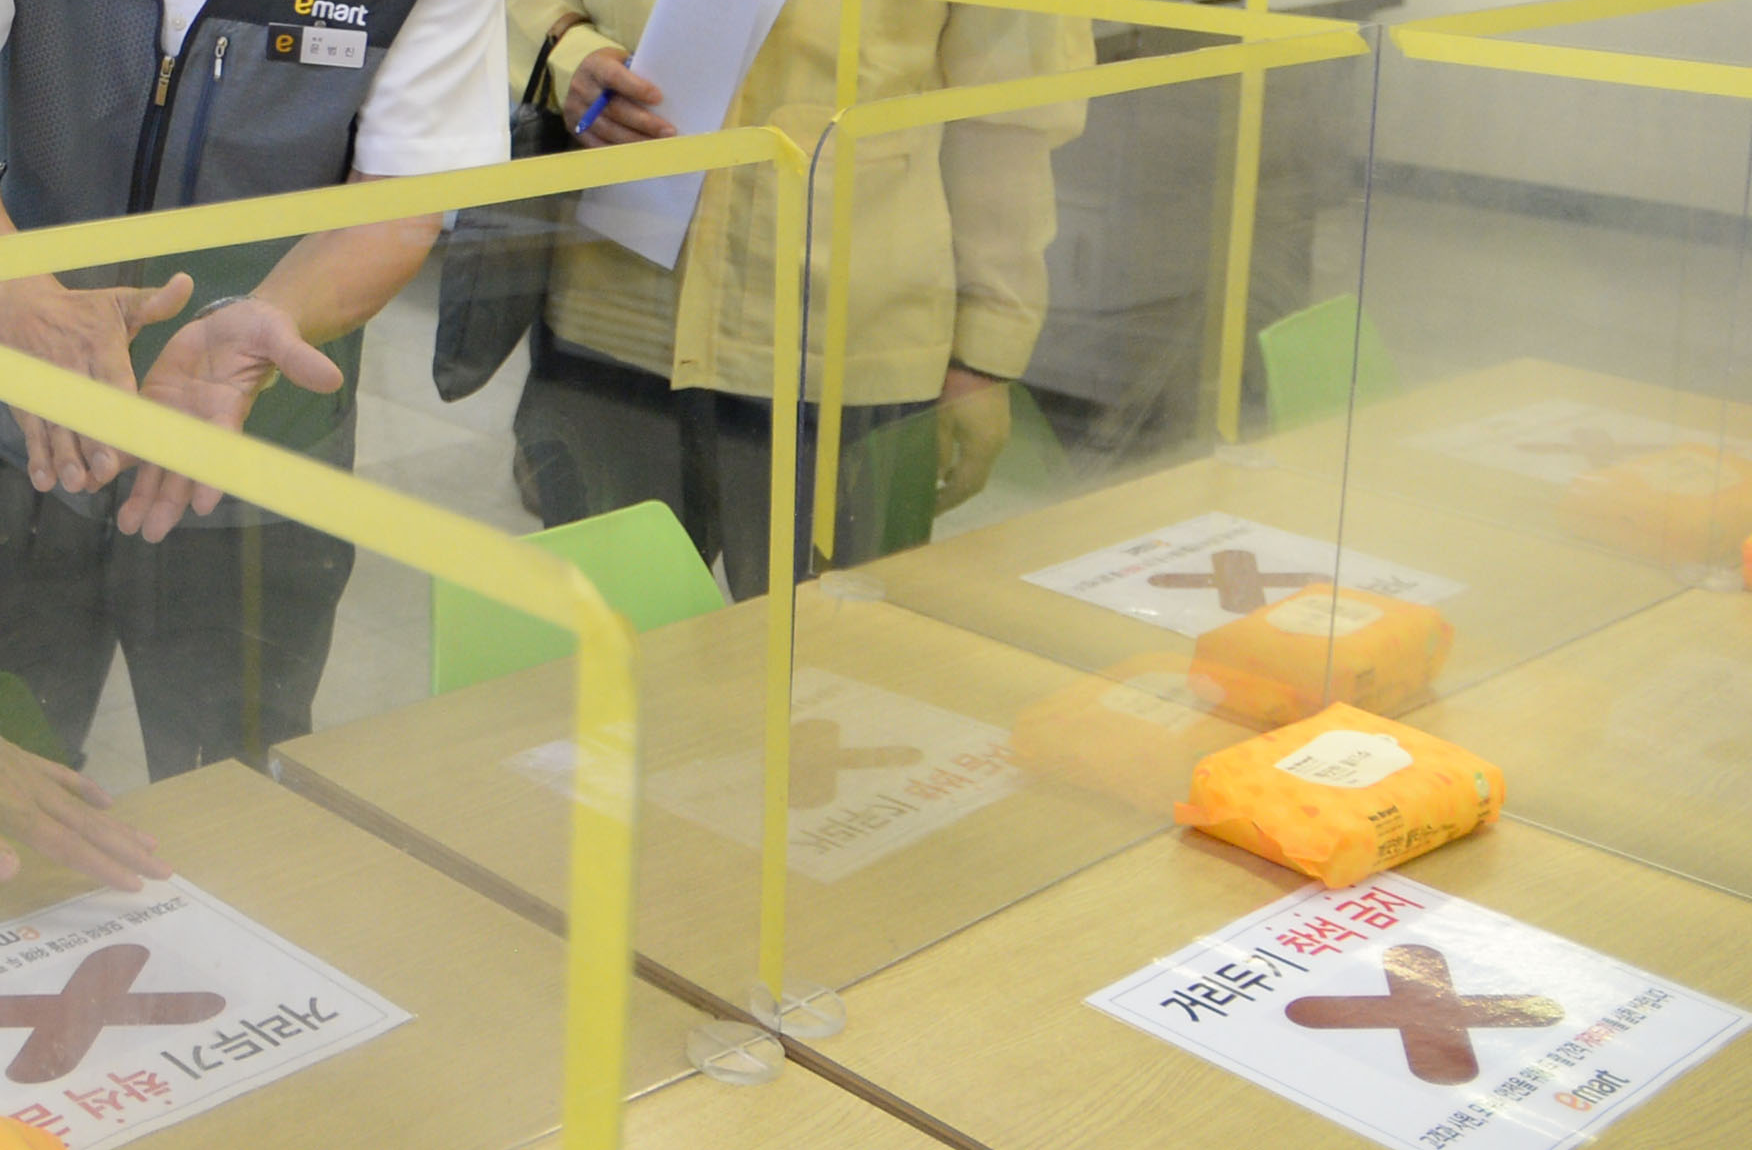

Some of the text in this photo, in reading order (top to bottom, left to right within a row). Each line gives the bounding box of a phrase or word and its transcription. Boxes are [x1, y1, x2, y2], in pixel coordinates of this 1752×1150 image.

[275, 34, 294, 53] e
[1160, 886, 1424, 1022] 거리두기 착석 금지
[8, 997, 338, 1145] 거리두기 착석 금
[1555, 1070, 1630, 1111] emart
[1420, 1124, 1461, 1150] 고객과
